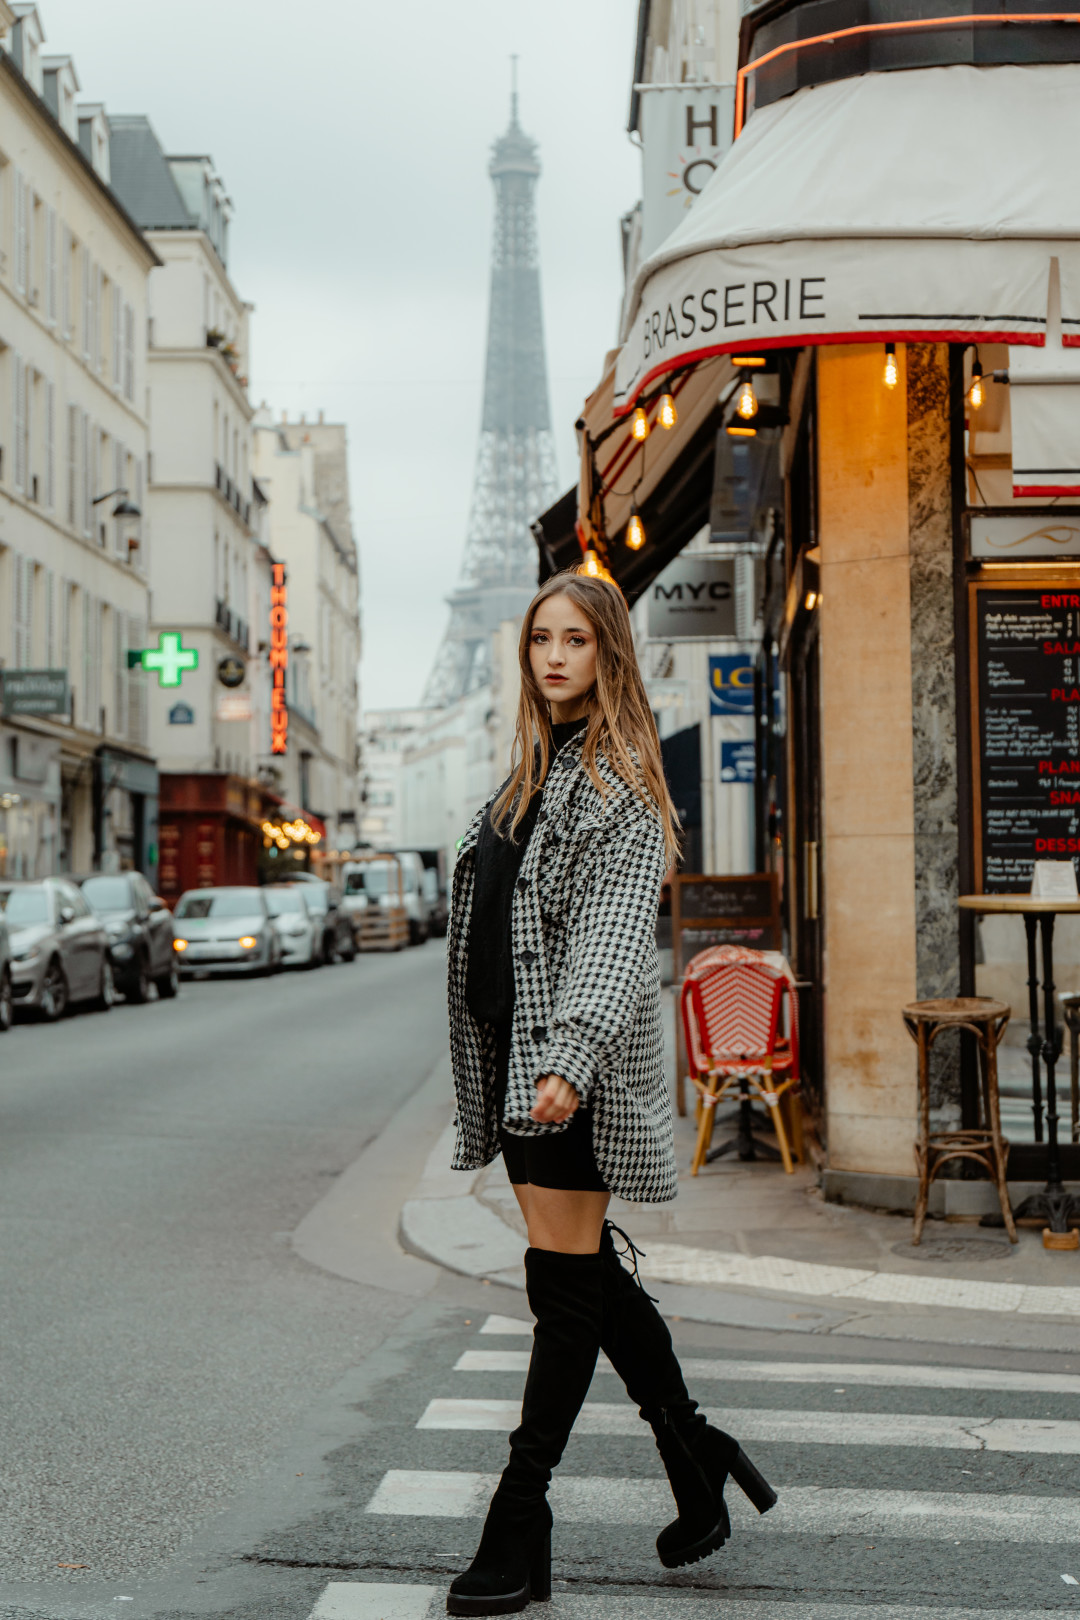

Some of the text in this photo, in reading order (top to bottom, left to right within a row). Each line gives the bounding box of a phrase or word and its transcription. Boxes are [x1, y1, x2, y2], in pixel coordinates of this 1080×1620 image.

[644, 277, 826, 360] BRASSERIE
[655, 581, 731, 600] MYC
[1035, 838, 1080, 853] DESS
